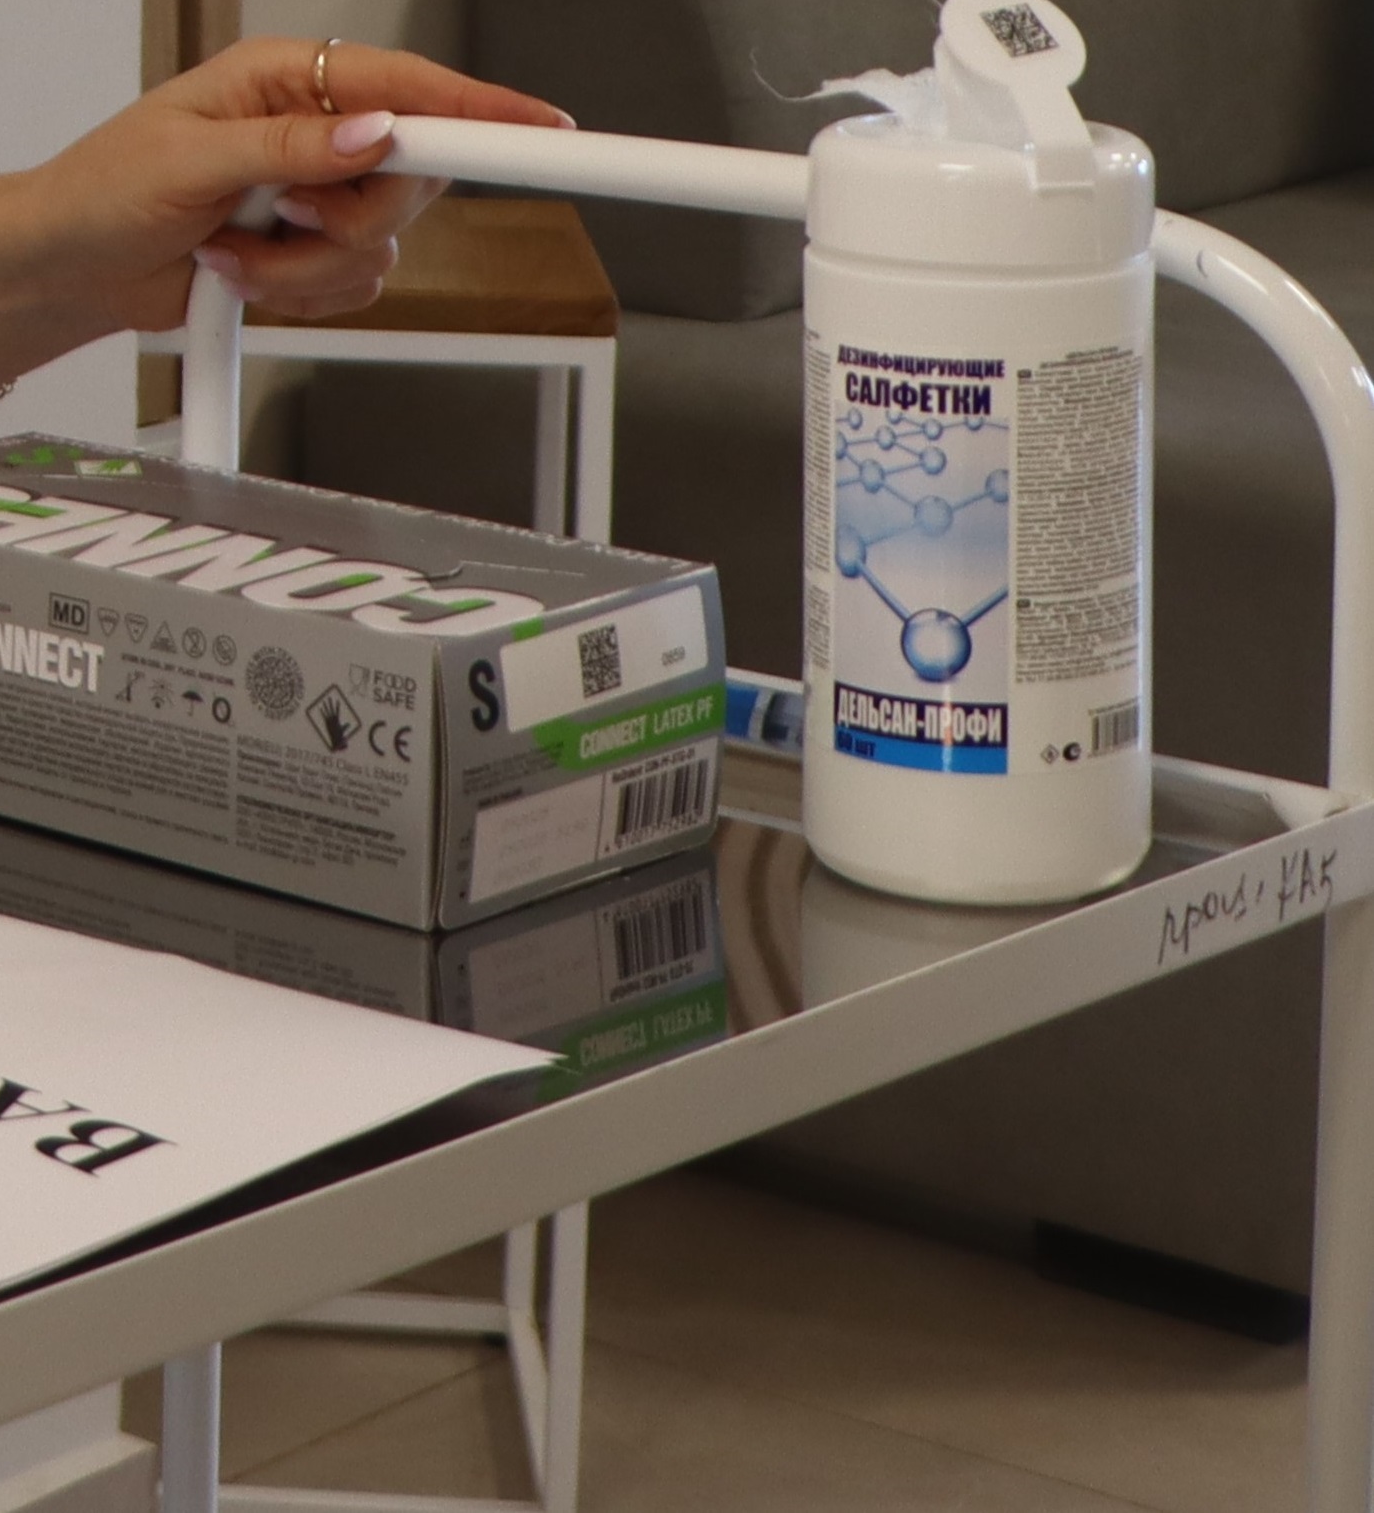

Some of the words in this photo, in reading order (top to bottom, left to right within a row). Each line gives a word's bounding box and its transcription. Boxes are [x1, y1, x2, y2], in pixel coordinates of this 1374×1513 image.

[837, 344, 1005, 379] ДЕЗИНФИЦИРУЮЩИЕ
[845, 371, 992, 415] САЛФЕТКИ
[53, 600, 85, 628] MD
[373, 688, 416, 712] SAFE
[374, 670, 417, 694] FOOD
[467, 659, 500, 732] S
[579, 714, 646, 759] CONNECT
[653, 702, 695, 735] LATEX
[697, 695, 714, 722] PF
[837, 687, 1002, 743] ДЕЛЬСАН-ПРОФИ
